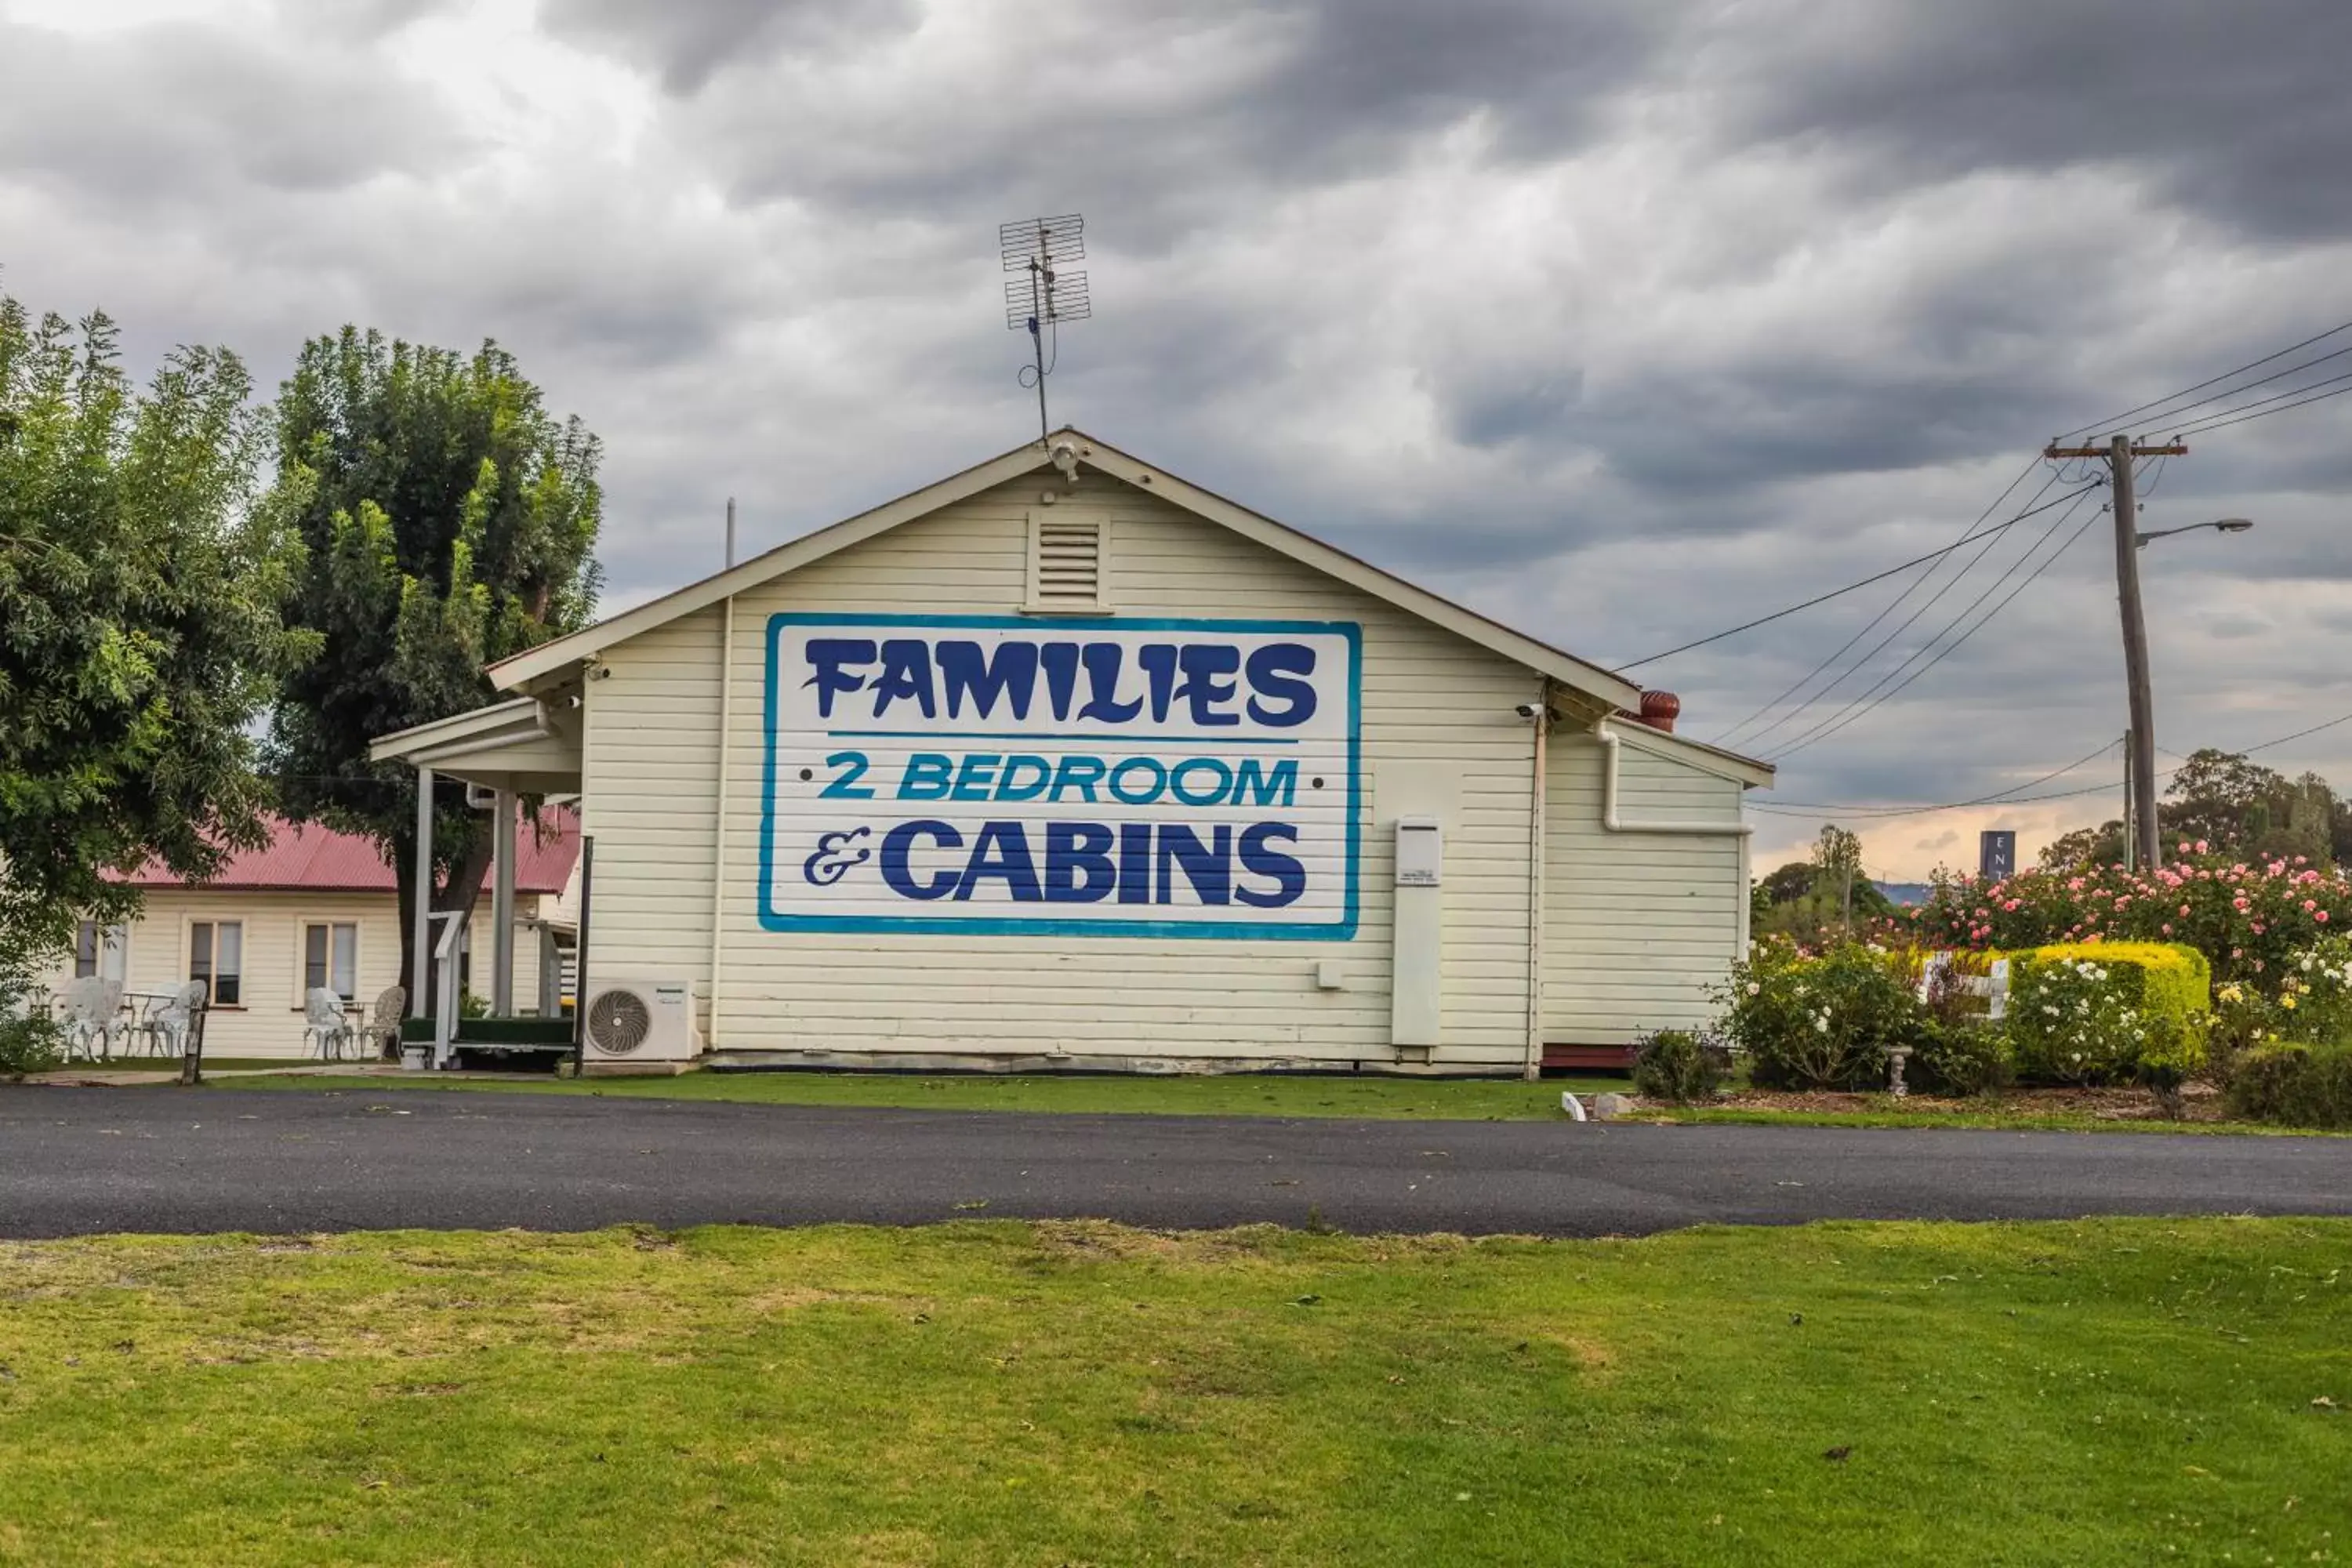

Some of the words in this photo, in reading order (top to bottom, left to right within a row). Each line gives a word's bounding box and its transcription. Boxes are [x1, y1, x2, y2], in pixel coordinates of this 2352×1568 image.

[801, 638, 1318, 728] FAMILIES
[818, 750, 876, 800] 2
[896, 753, 1299, 807] BEDROOM
[804, 826, 871, 887] &
[879, 819, 1306, 908] CABINS
